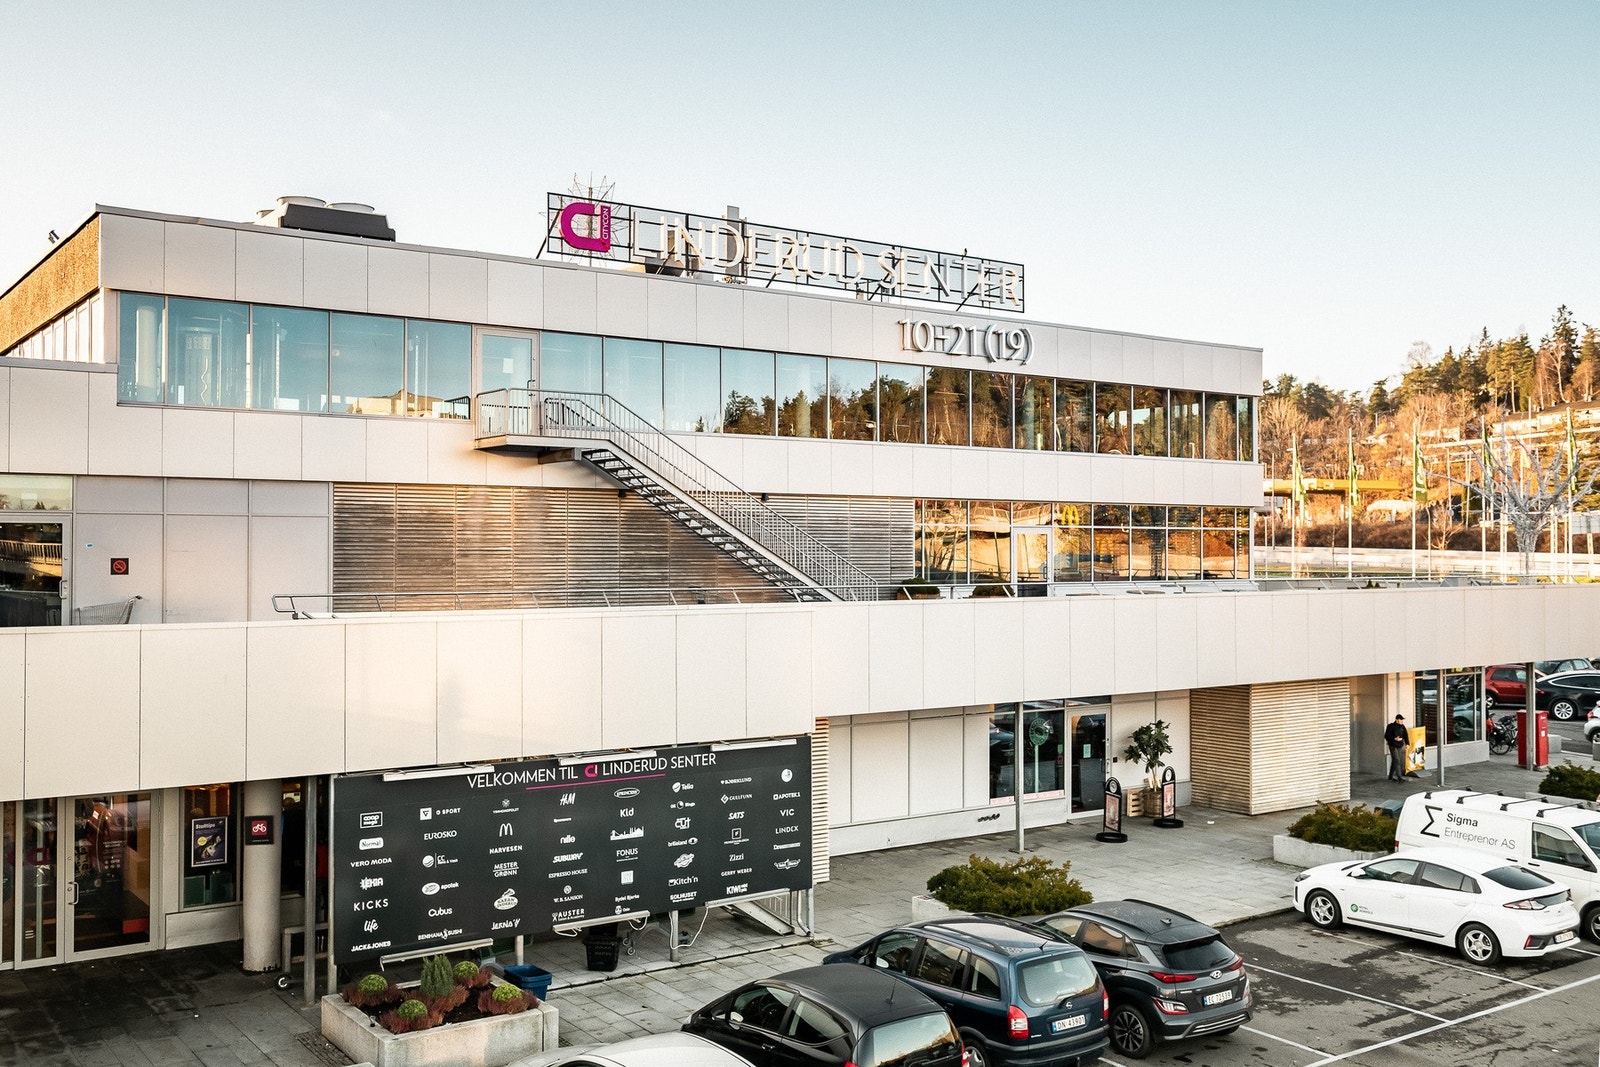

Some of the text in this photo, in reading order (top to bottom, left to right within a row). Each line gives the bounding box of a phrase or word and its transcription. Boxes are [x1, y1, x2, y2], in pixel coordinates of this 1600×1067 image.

[633, 210, 1021, 307] LINDERUD SENTER
[985, 322, 1035, 365] (19)
[467, 753, 717, 789] VELKOMMEN TIL LINDERUD SENTER
[560, 793, 576, 805] H&M
[442, 807, 461, 815] SPORT
[620, 807, 635, 817] Kid
[728, 811, 745, 820] SATS
[780, 809, 795, 817] VIC
[1446, 813, 1479, 827] Sigma
[775, 825, 799, 834] LINDEX
[423, 830, 458, 841] EUROSKO
[1500, 838, 1516, 850] AS
[489, 845, 523, 854] NARVESEN
[616, 848, 639, 857] FONUS
[350, 857, 393, 868] VERO MODA
[552, 852, 583, 863] SUBWAY
[729, 853, 744, 862] Zizzi
[493, 861, 518, 870] MESTER
[548, 868, 588, 879] ESPRESSO HOUSE
[721, 867, 752, 877] GERRY WEBER
[353, 898, 389, 912] KICKS
[428, 907, 453, 917] Cubus
[558, 908, 585, 918] AUSTER
[351, 940, 391, 952] JACK&JONES
